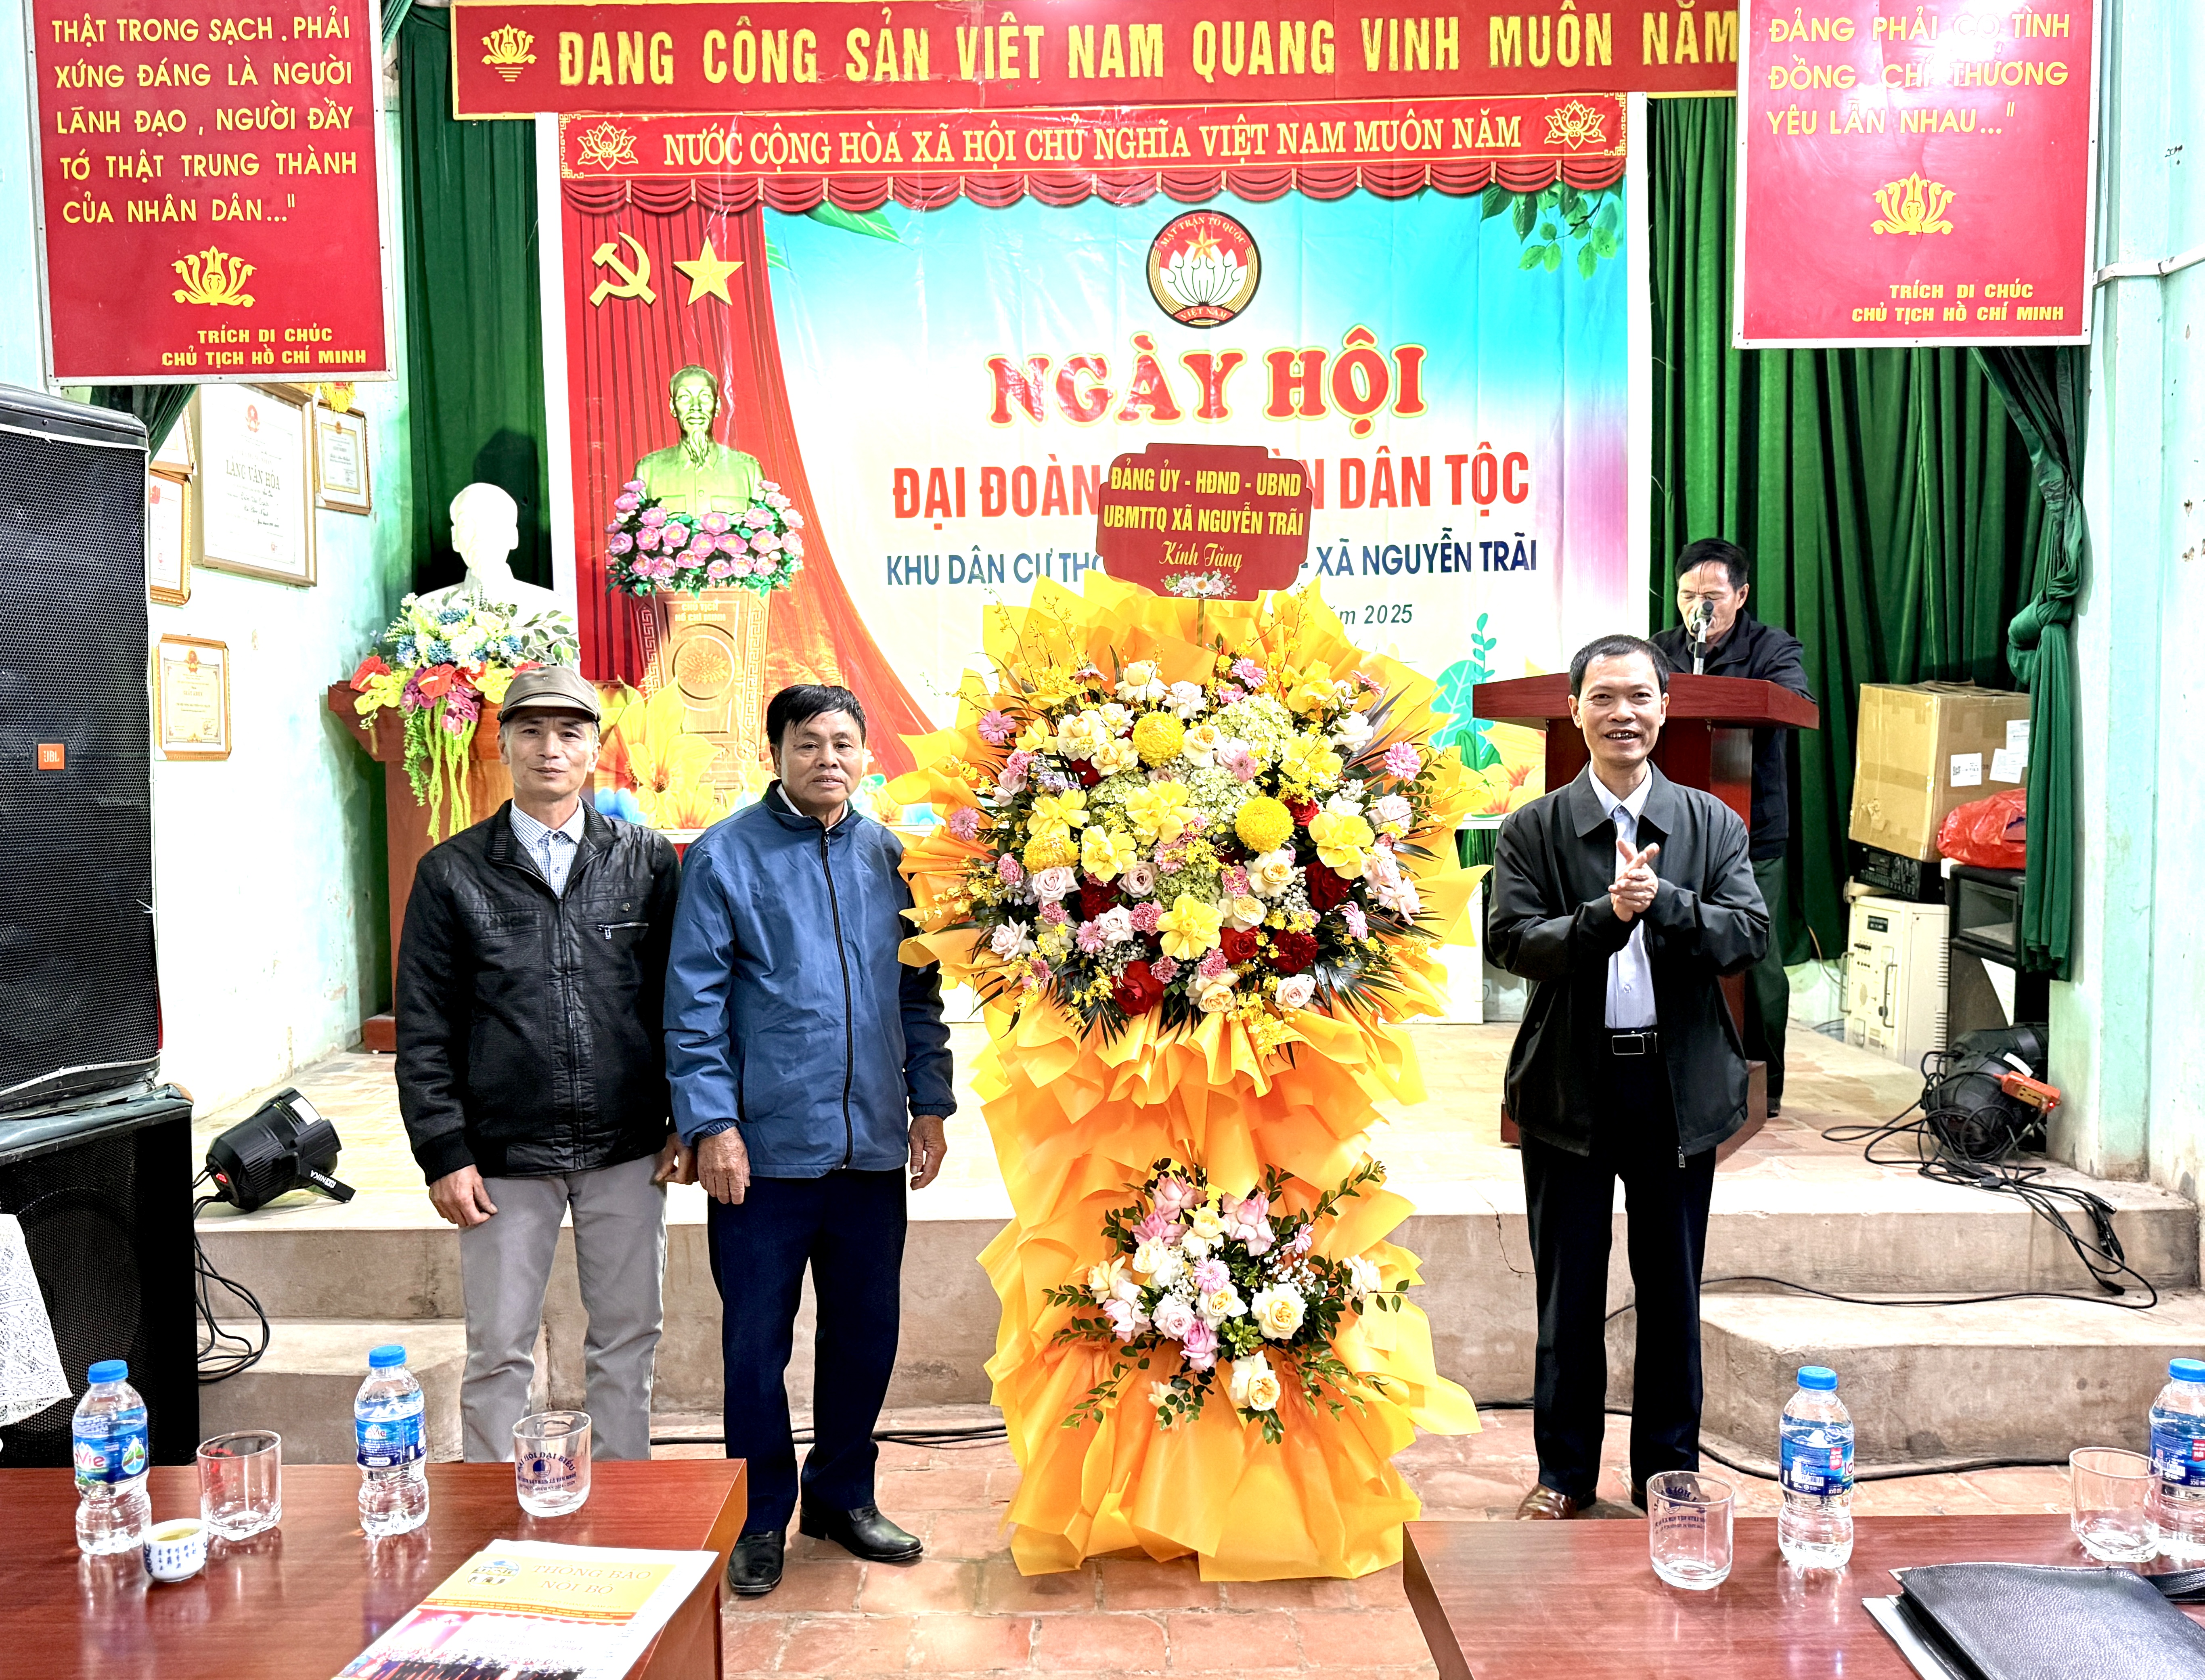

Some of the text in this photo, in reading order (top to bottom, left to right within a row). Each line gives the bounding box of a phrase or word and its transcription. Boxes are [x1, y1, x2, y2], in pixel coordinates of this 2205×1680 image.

[52, 13, 106, 47] THẬT
[117, 18, 198, 42] TRONG
[208, 17, 273, 49] SẠCH
[293, 6, 350, 39] PHẢI
[1769, 7, 1855, 42] ĐẢNG
[1872, 6, 1937, 41] PHẢI
[2012, 5, 2069, 38] TÌNH
[846, 7, 929, 83] SẢN
[1068, 23, 1163, 79] NAM
[1193, 20, 1334, 82] QUANG
[1361, 17, 1459, 71] VINH
[1489, 0, 1612, 68] MUÔN
[54, 54, 352, 89] XỨNG ĐÁNG LÀ NGƯỜI
[1768, 54, 2068, 90] ĐỒNG CHÍ THƯƠNG
[57, 107, 121, 134] LÃNH
[135, 109, 186, 137] ĐẠO
[216, 100, 295, 130] NGƯỜI
[308, 97, 354, 130] ĐẦY
[1766, 104, 1817, 135] YÊU
[664, 109, 1522, 173] NƯỚC CỘNG HÒA XÃ HỘI CHỦ NGHĨA VIỆT NAM MUÔN NĂM
[60, 145, 357, 183] TỚ THẬT TRUNG THÀNH
[63, 192, 114, 224] CỦA
[128, 193, 197, 223] NHÂN
[1889, 278, 2033, 299] TRÍCH DI CHÚC
[1852, 301, 2064, 325] CHỦ TỊCH HỒ CHÍ MINH
[197, 322, 333, 344] TRÍCH DI CHÚC
[161, 344, 366, 369] CHỦ TỊCH HỒ CHÍ MINH
[985, 324, 1427, 438] NGÀY HỘI
[892, 467, 966, 530] ĐẠI
[980, 454, 1101, 518] ĐOÀN
[1340, 445, 1431, 510] DÂN
[1445, 441, 1529, 517] TỘC
[1111, 458, 1155, 492] ĐẢNG
[1160, 459, 1181, 492] ỦY
[1196, 470, 1240, 494] HĐND
[1256, 472, 1301, 496] UBND
[1104, 502, 1304, 536] UBMTTQ XÃ NGUYỄN TRÃI
[887, 555, 939, 585] KHU
[949, 545, 1005, 584] DÂN
[1315, 539, 1354, 576] XÃ
[1363, 527, 1472, 576] NGUYỄN
[1479, 532, 1537, 572] TRÃI
[1159, 540, 1199, 566] Kính
[1364, 604, 1412, 624] 2025
[43, 750, 59, 762] JBL
[533, 1565, 651, 1579] THÔNG BÁO
[540, 1580, 614, 1596] NỘI BỘ
